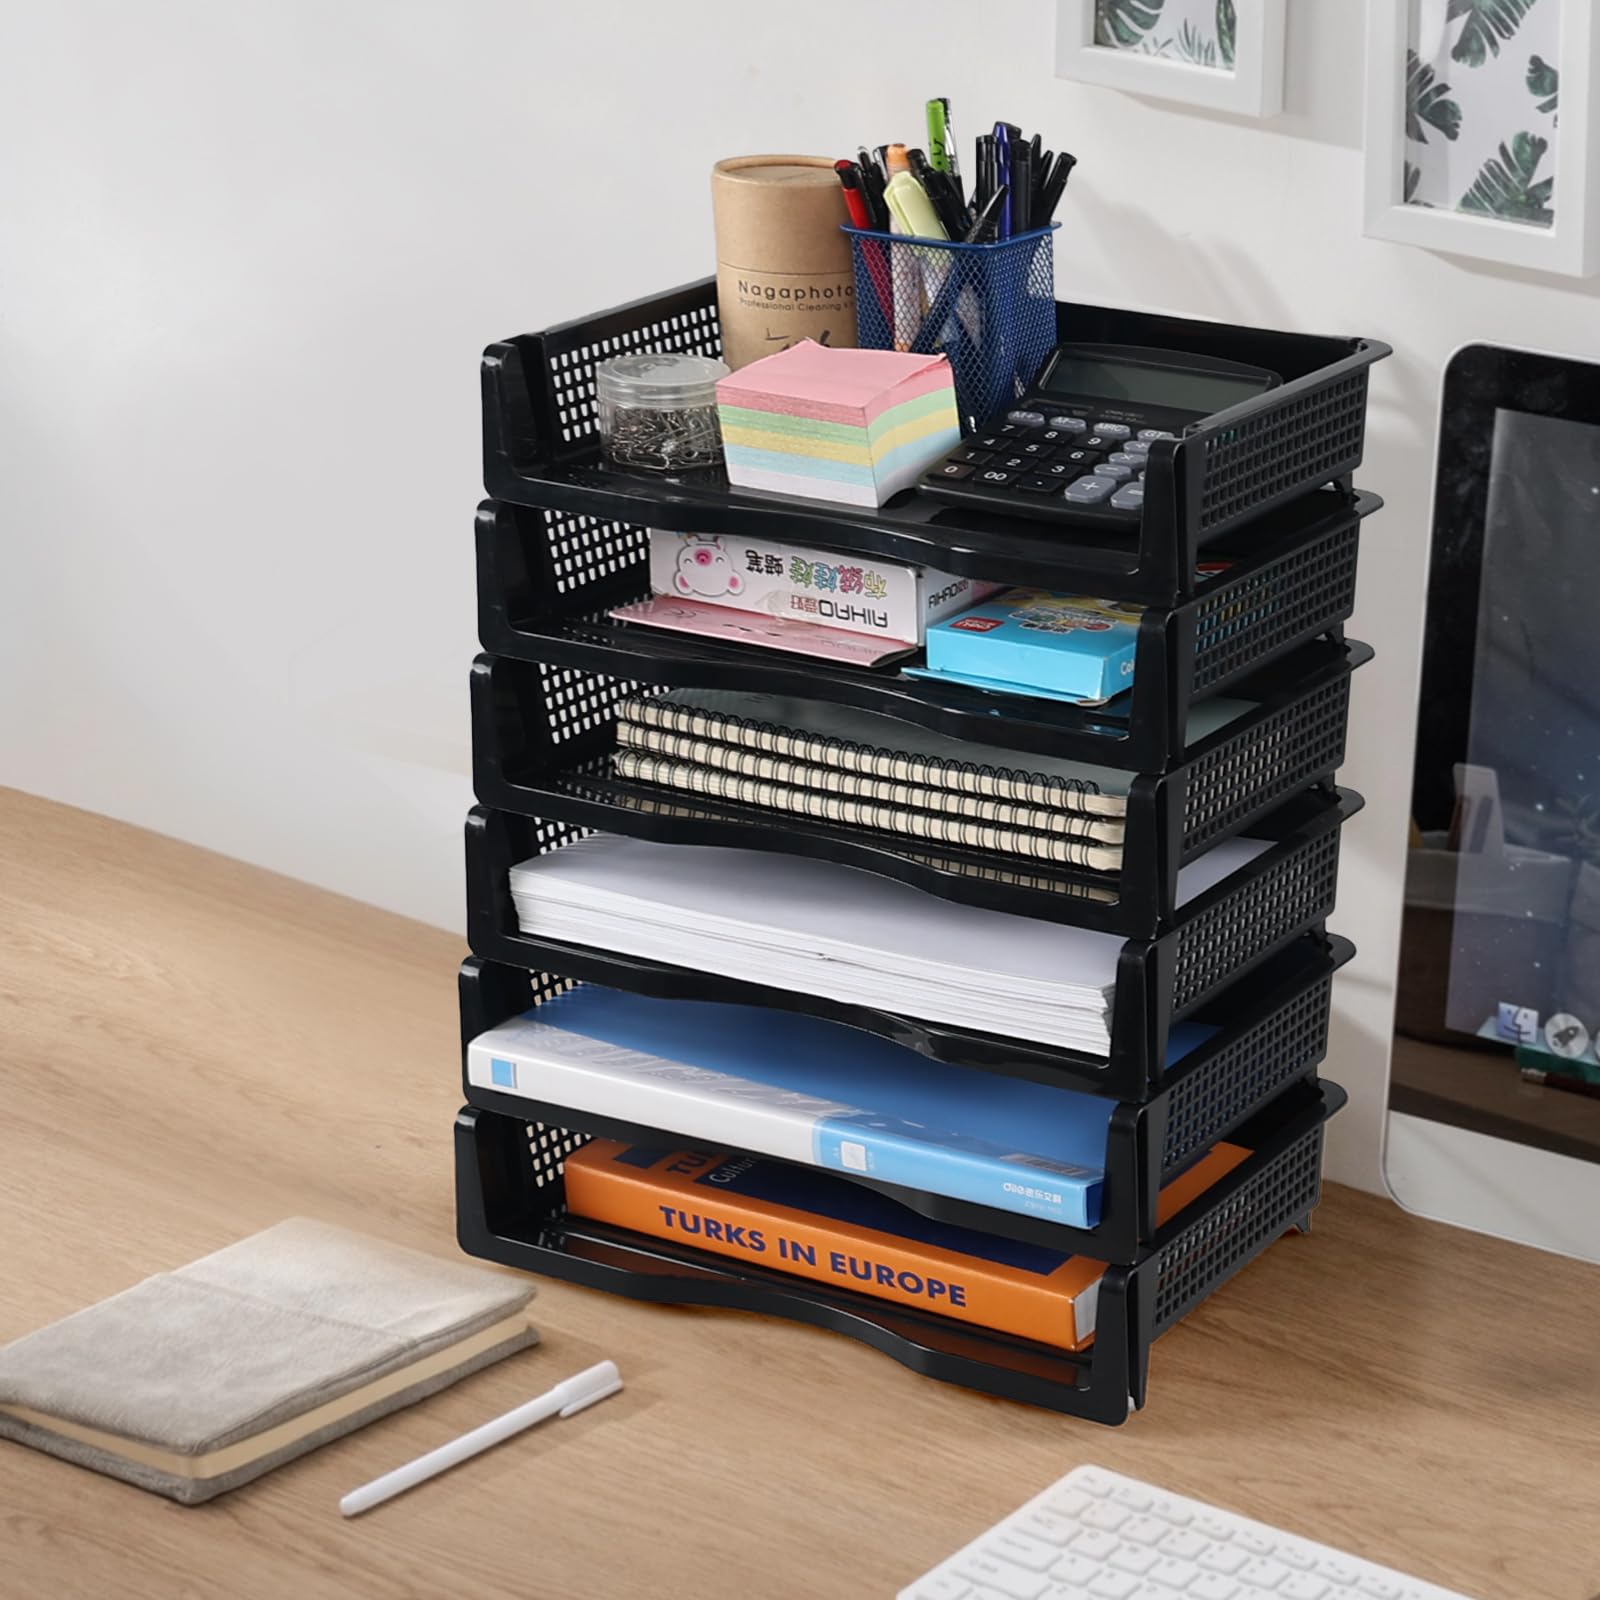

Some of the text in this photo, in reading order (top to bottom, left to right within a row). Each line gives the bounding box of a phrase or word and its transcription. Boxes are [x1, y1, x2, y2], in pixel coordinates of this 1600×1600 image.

[738, 280, 855, 301] Nagaphoto
[740, 299, 795, 312] Professional
[798, 303, 841, 313] Cleaning
[1044, 431, 1059, 439] 8
[1087, 437, 1102, 445] 9
[1025, 444, 1040, 452] 5
[1069, 451, 1085, 459] 6
[944, 465, 958, 473] 0
[983, 471, 1007, 480] 00
[1006, 458, 1021, 466] 2
[1050, 465, 1065, 473] 3
[928, 582, 958, 609] AIHAO
[818, 599, 888, 628] AIHAO
[658, 1205, 967, 1308] TURKS IN EUROPE
